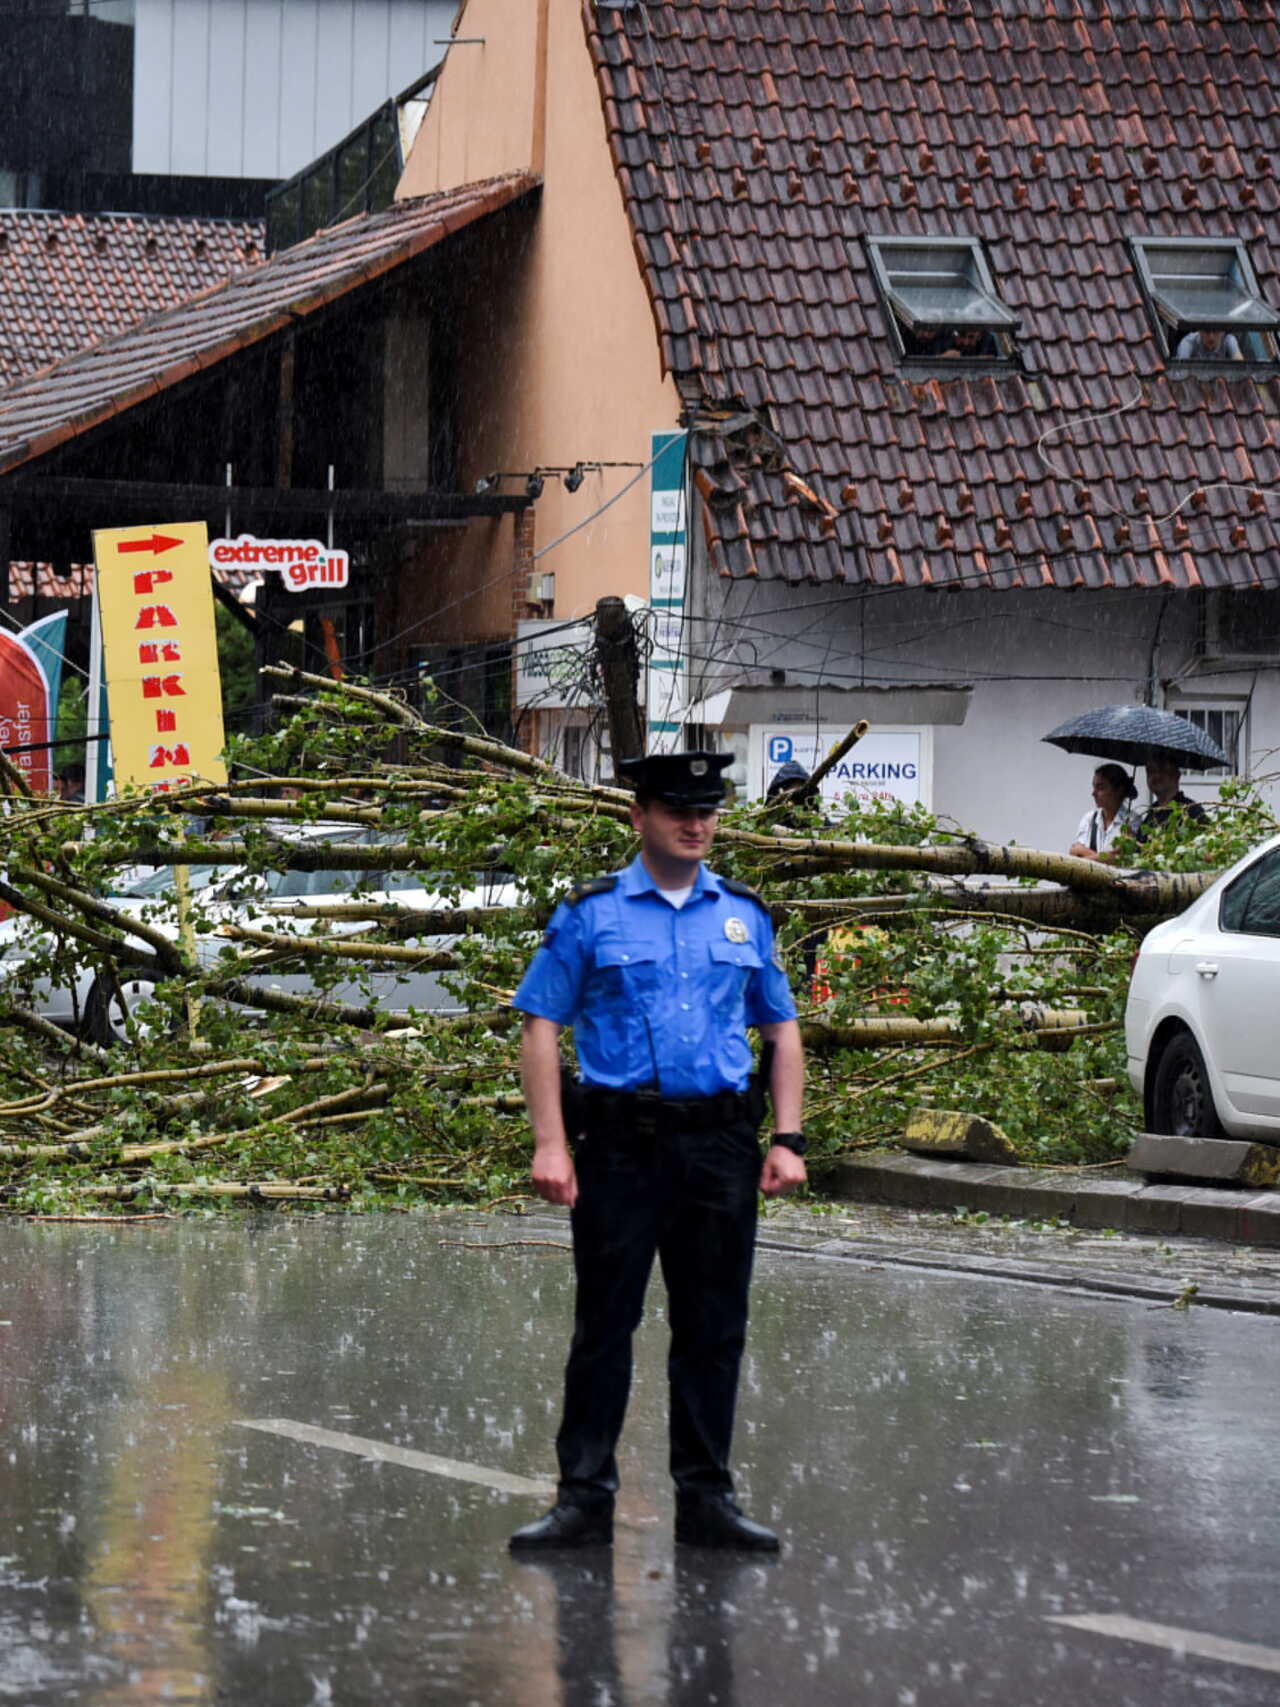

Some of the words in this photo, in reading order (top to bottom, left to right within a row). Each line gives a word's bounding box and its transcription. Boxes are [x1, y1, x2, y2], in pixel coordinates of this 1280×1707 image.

[214, 541, 319, 562] extreme
[289, 557, 344, 585] grill
[826, 763, 917, 780] PARKING
